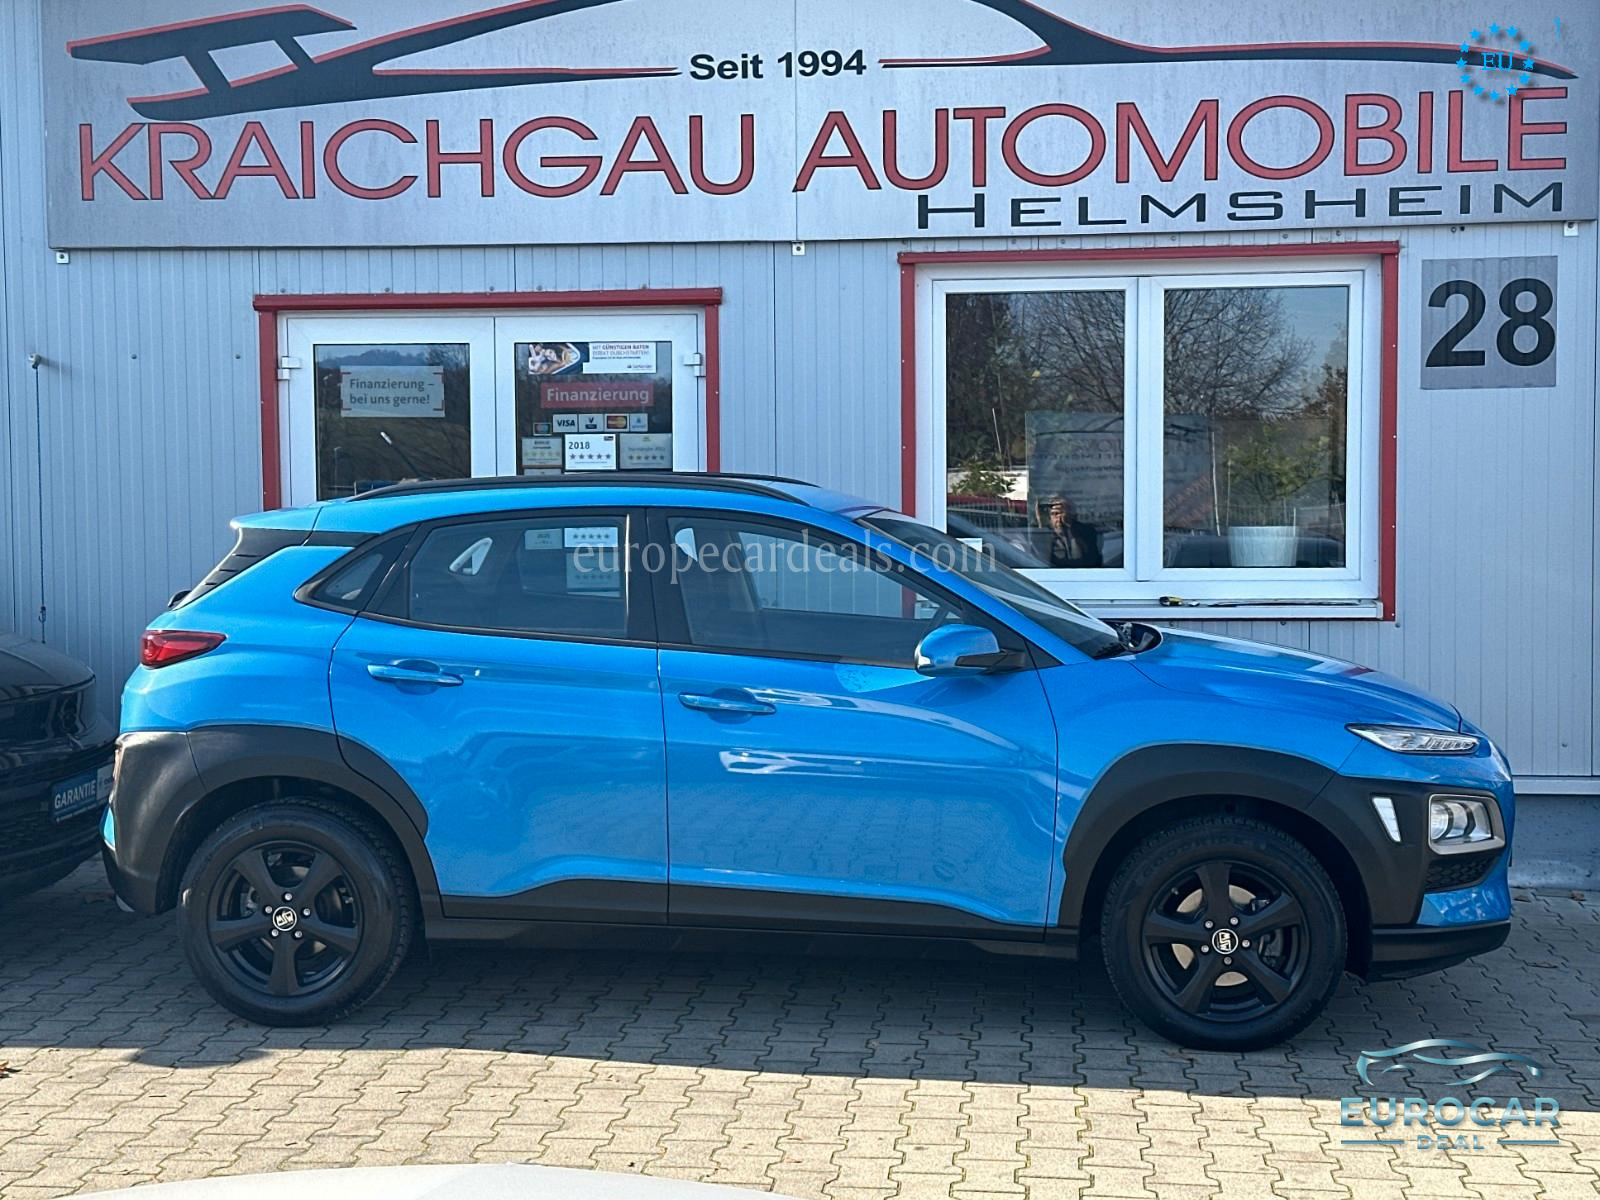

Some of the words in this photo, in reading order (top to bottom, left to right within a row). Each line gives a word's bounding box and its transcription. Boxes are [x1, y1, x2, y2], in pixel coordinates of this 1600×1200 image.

[690, 53, 764, 80] Seit
[777, 50, 867, 78] 1994
[79, 114, 755, 200] KRAICHGAU
[793, 87, 1568, 192] AUTOMOBILE
[918, 182, 1563, 229] HELMSHEIM
[1425, 278, 1556, 367] 28
[350, 379, 424, 392] Finanzierung
[546, 387, 649, 404] Finanzierung
[350, 394, 367, 404] bei
[370, 395, 390, 404] uns
[392, 394, 430, 407] gerne!
[557, 419, 576, 427] VISA
[568, 441, 590, 450] 2018
[54, 779, 97, 809] GARANTIE
